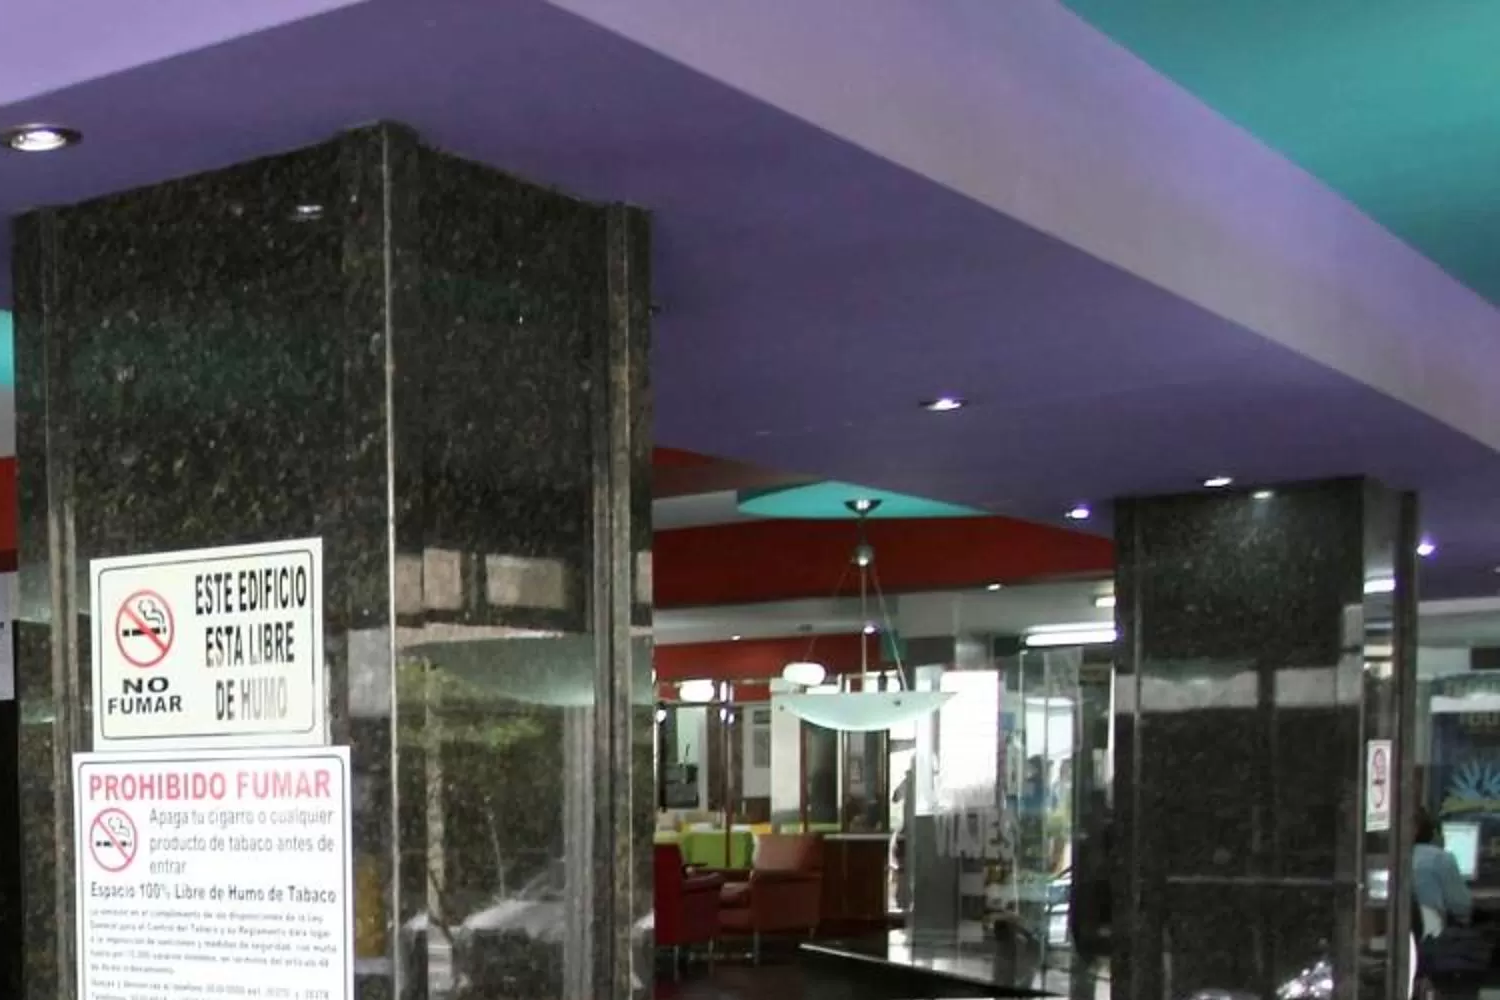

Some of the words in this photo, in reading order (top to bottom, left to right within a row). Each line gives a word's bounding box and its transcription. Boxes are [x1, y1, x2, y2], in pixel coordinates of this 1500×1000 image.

[195, 572, 233, 615] ESTE
[239, 565, 307, 611] EDIFICIO
[205, 625, 244, 667] ESTA
[249, 621, 295, 666] LIBRE
[122, 676, 170, 695] NO
[108, 695, 183, 715] FUMAR
[215, 680, 235, 721] DE
[240, 676, 287, 721] HUMO
[89, 772, 226, 801] PROHIBIDO
[236, 769, 331, 800] FUMAR
[149, 808, 189, 828] Apaga
[192, 809, 205, 824] tu
[208, 807, 254, 828] cigarro
[258, 812, 267, 824] o
[269, 807, 333, 829] cualquier
[149, 836, 210, 853] producto
[212, 835, 226, 852] de
[228, 835, 272, 852] tabaco
[275, 836, 313, 851] antes
[317, 834, 334, 851] de
[149, 860, 186, 874] entrar
[90, 882, 135, 900] Espacio
[175, 883, 205, 900] Libre
[209, 885, 225, 902] de
[228, 884, 265, 902] Humo
[268, 885, 283, 903] de
[288, 885, 336, 904] Tabaco
